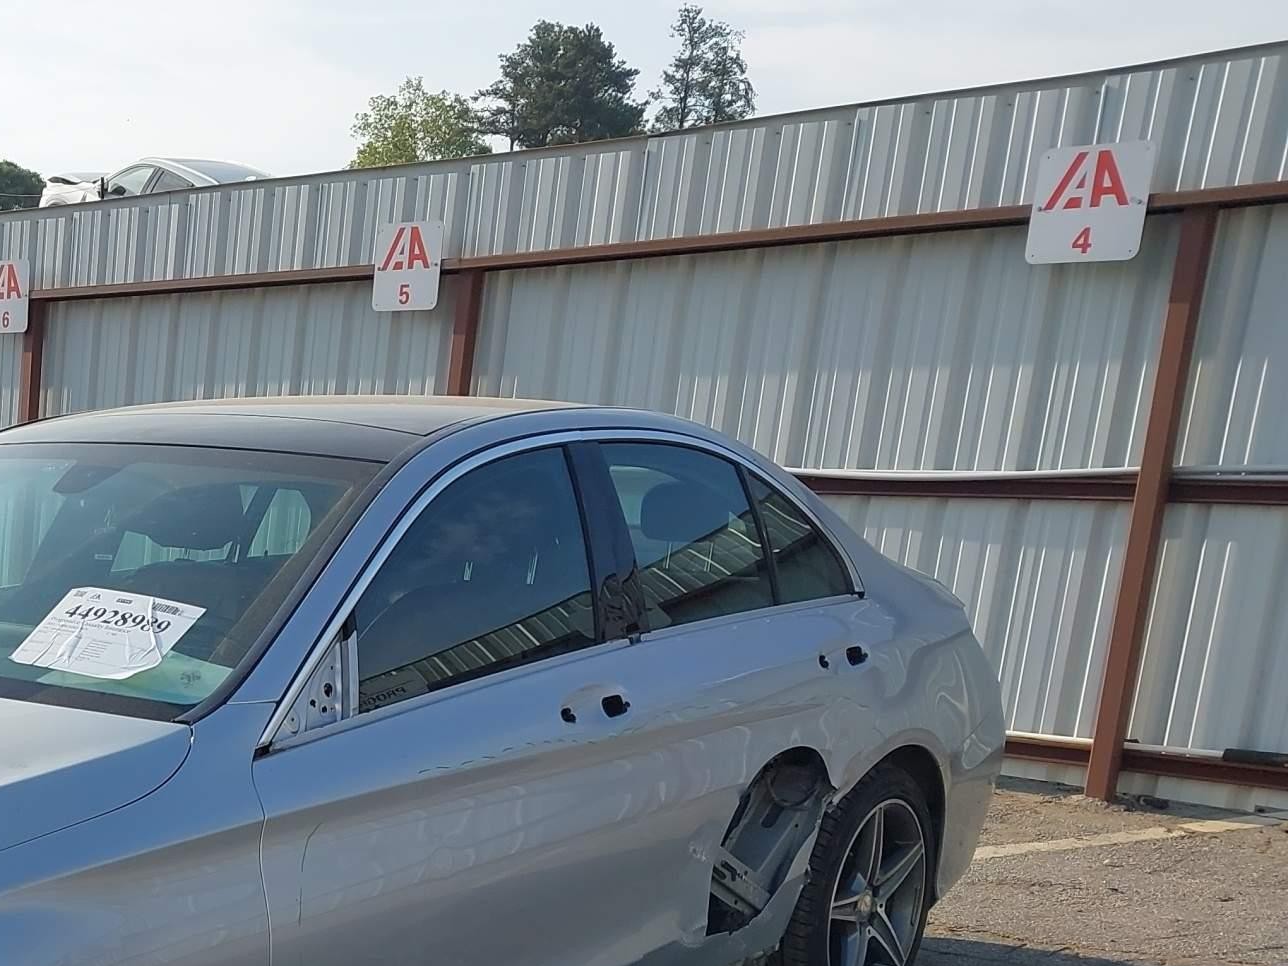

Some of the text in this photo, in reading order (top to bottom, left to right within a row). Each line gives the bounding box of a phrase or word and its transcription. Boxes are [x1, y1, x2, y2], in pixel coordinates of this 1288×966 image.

[1071, 226, 1092, 254] 4
[398, 284, 410, 304] 5
[2, 311, 10, 328] 6
[65, 604, 172, 634] 44928989
